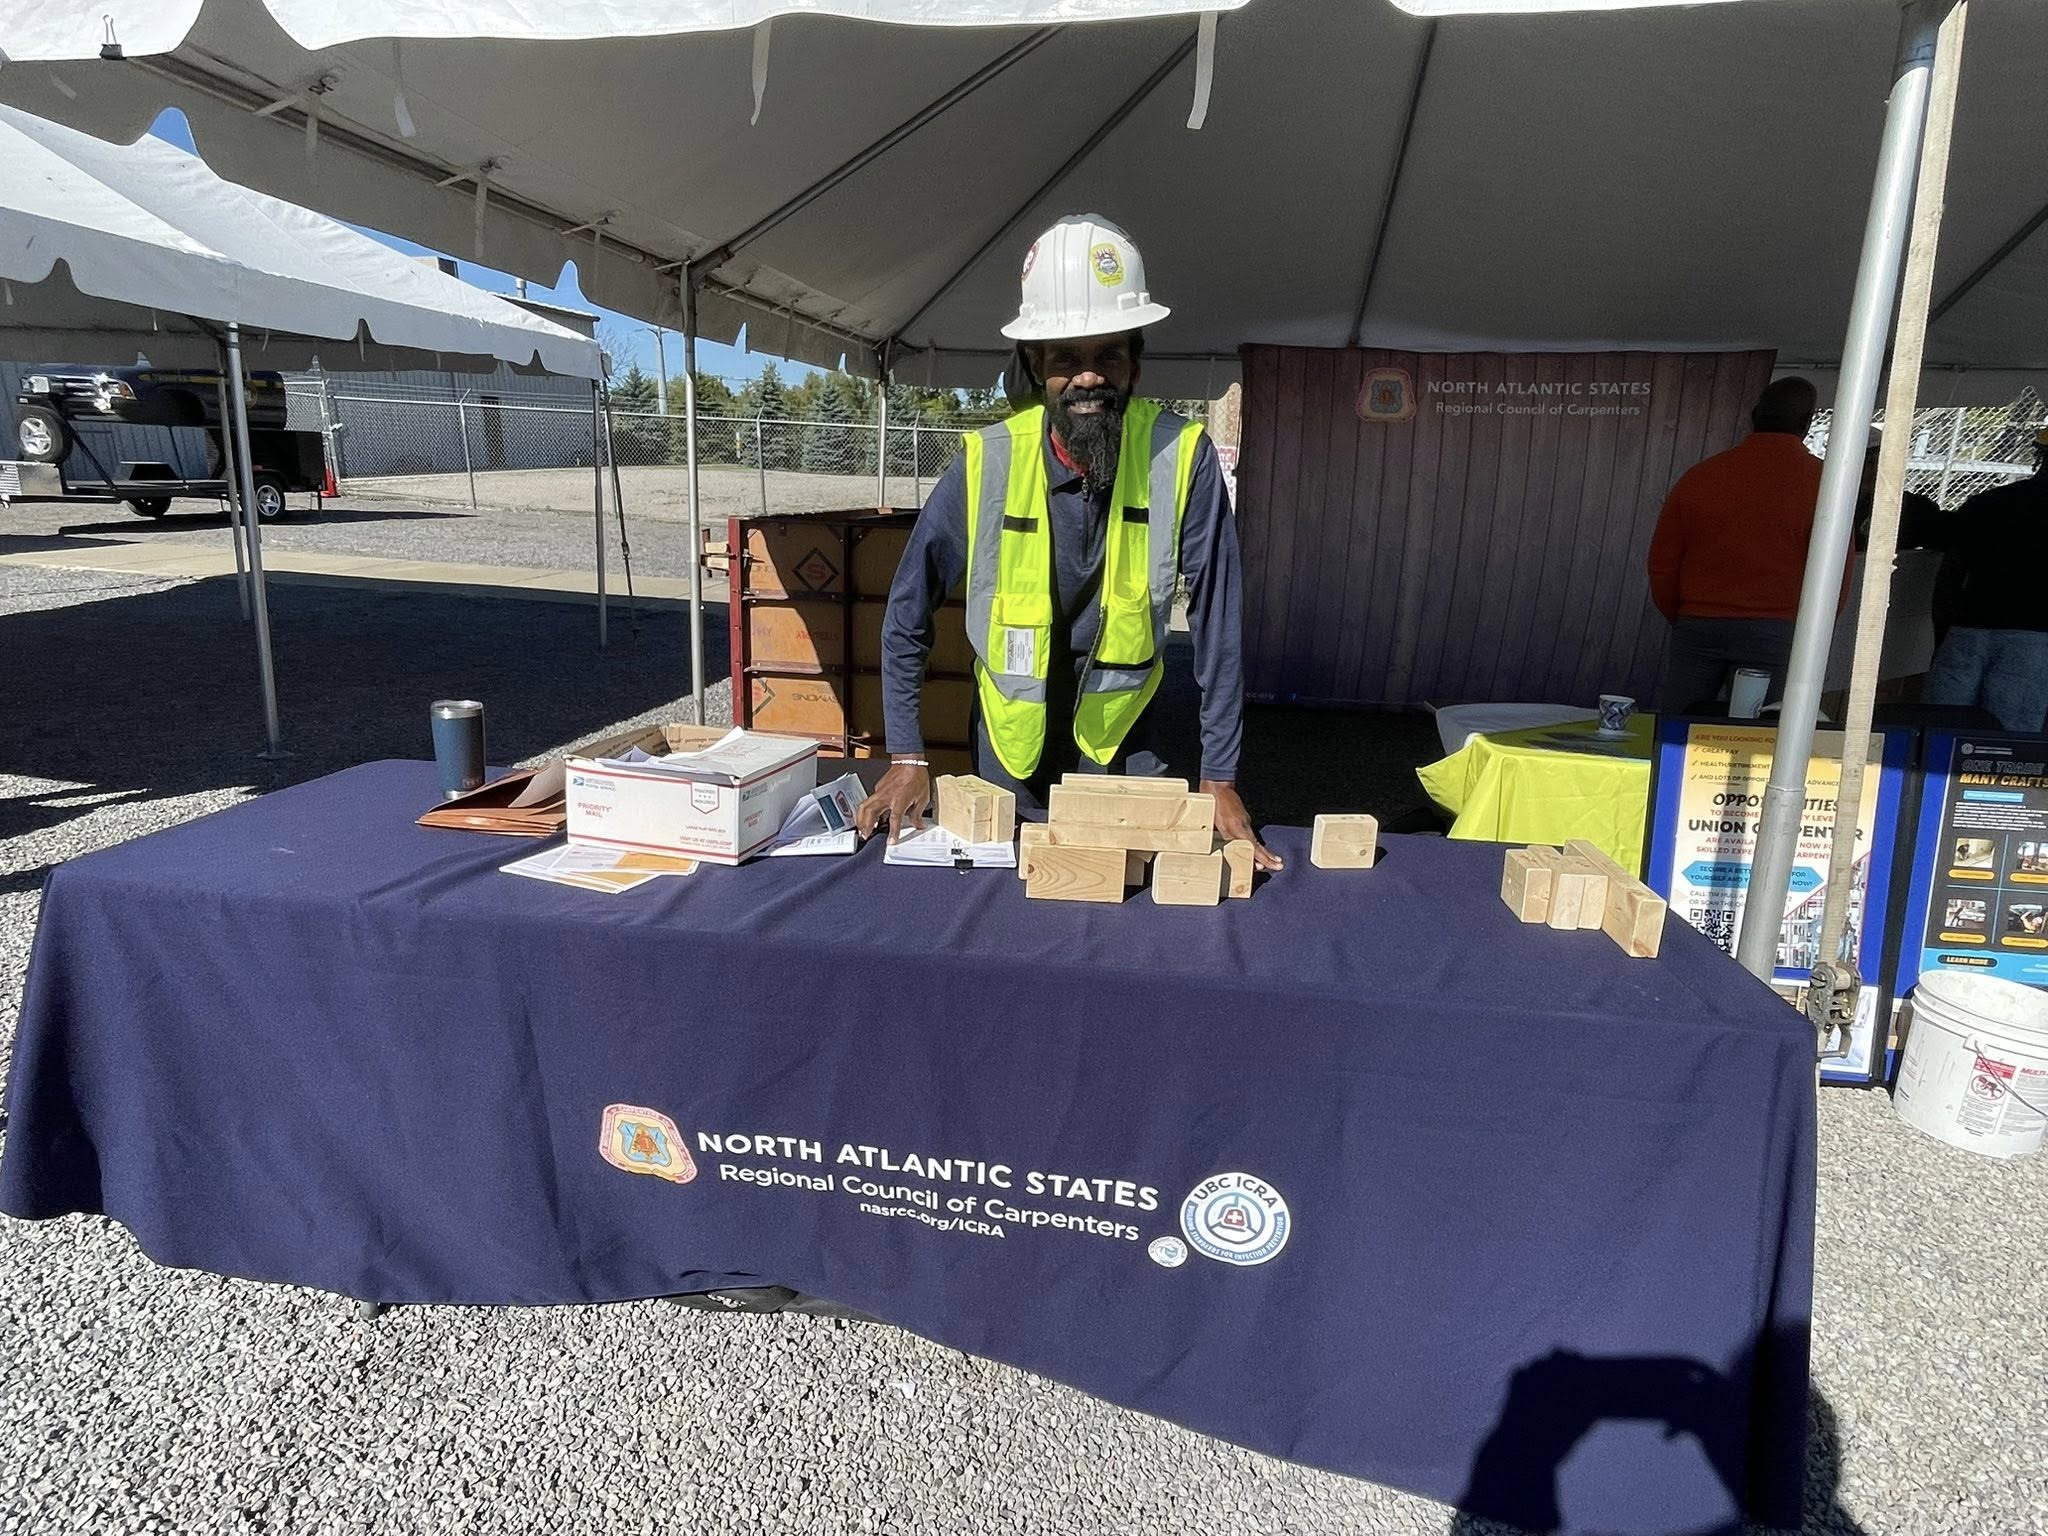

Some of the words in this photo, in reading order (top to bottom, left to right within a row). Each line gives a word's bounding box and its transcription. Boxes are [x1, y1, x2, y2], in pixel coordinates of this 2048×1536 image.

[1427, 381, 1488, 394] NORTH
[1495, 382, 1582, 395] ATLANTIC
[1588, 382, 1651, 395] STATES
[1435, 402, 1493, 415] Regional
[1496, 403, 1545, 416] Council
[1549, 403, 1564, 416] of
[1567, 403, 1640, 417] Carpenters
[1996, 760, 2045, 775] TRADE
[1960, 773, 1998, 785] MANY
[1723, 810, 1760, 818] BECOME
[1688, 819, 1746, 834] UNION
[1705, 836, 1722, 844] ARE
[1696, 846, 1730, 854] SKILLED
[697, 1131, 822, 1163] NORTH
[836, 1143, 1013, 1188] ATLANTIC
[1025, 1170, 1160, 1211] STATES
[1193, 1177, 1231, 1200] UBC
[1236, 1176, 1278, 1208] ICRA
[719, 1163, 834, 1192] Regional
[842, 1175, 938, 1209] Council
[946, 1195, 977, 1214] of
[984, 1199, 1140, 1241] Carpenters
[859, 1202, 1006, 1239] nasrcc.org/ICRA
